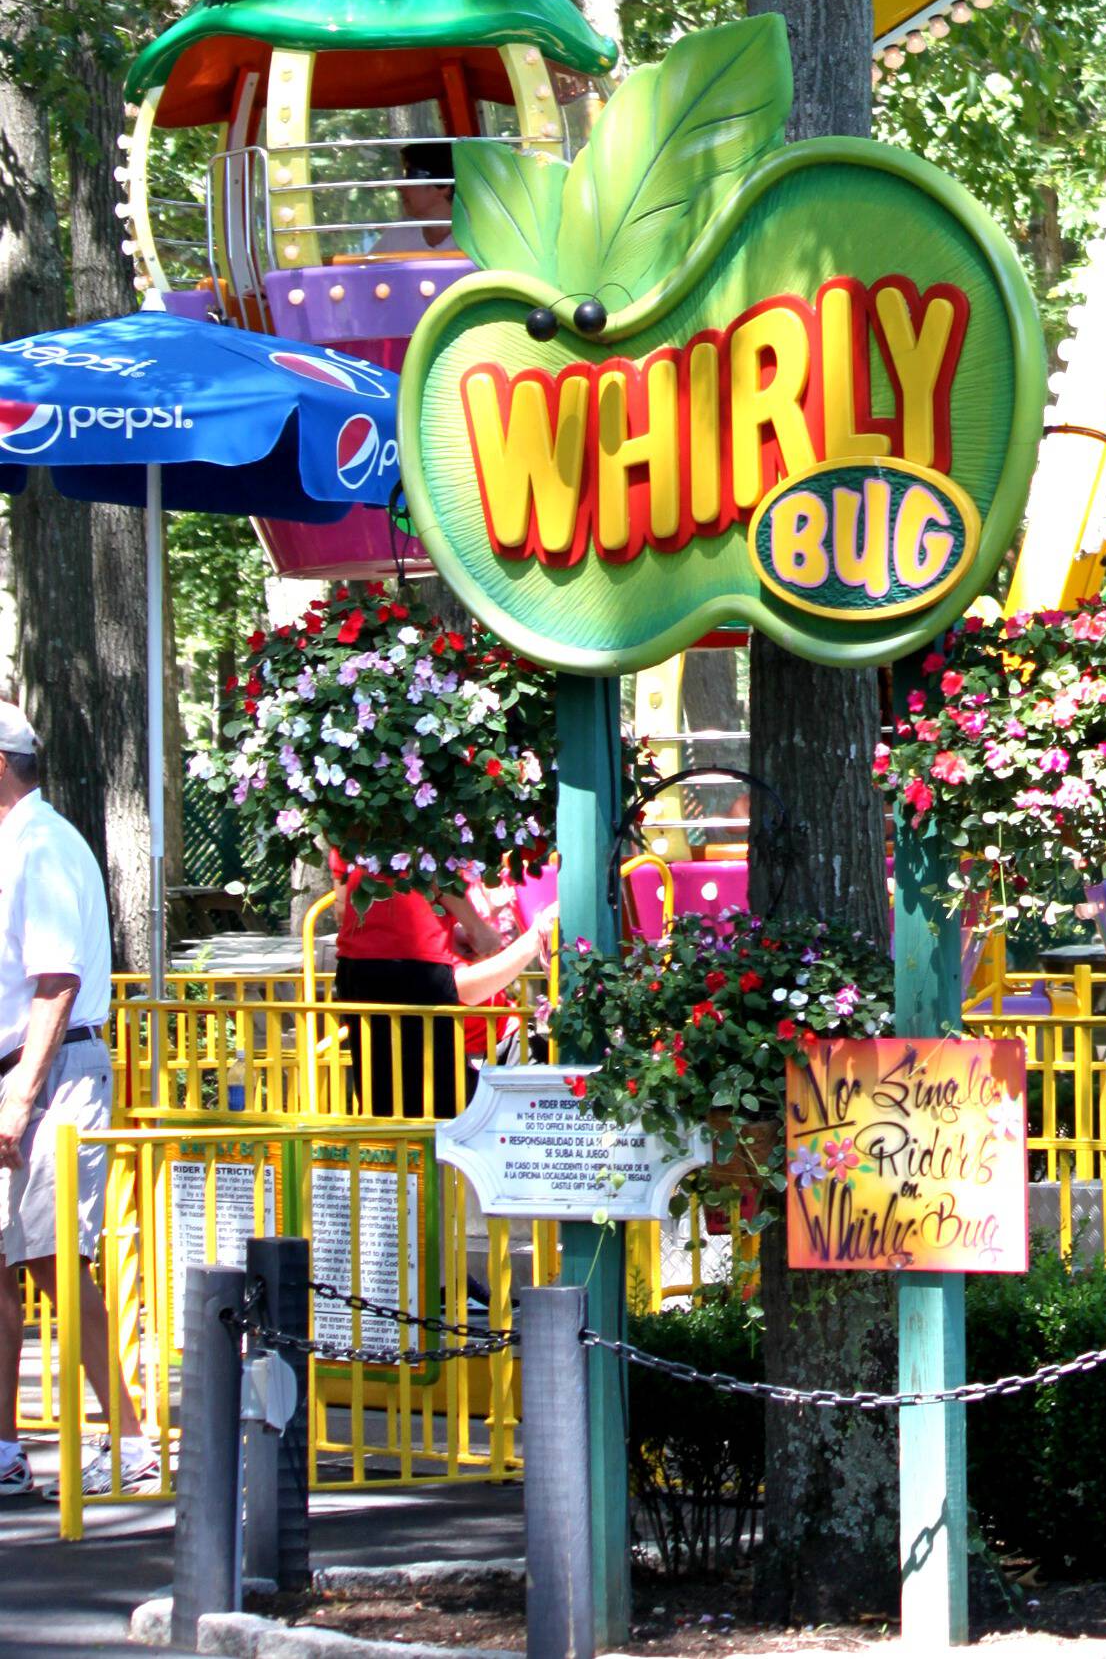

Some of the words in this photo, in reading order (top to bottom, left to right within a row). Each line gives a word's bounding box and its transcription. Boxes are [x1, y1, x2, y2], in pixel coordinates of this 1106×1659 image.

[69, 405, 183, 439] pepsi
[462, 275, 969, 567] WHIRLY
[768, 478, 956, 599] BUG
[538, 1099, 558, 1109] RIDER
[792, 1041, 861, 1127] No
[872, 1044, 1002, 1124] Single
[173, 1165, 201, 1174] RIDER
[793, 1175, 917, 1268] Whirly
[920, 1192, 1003, 1266] Bug
